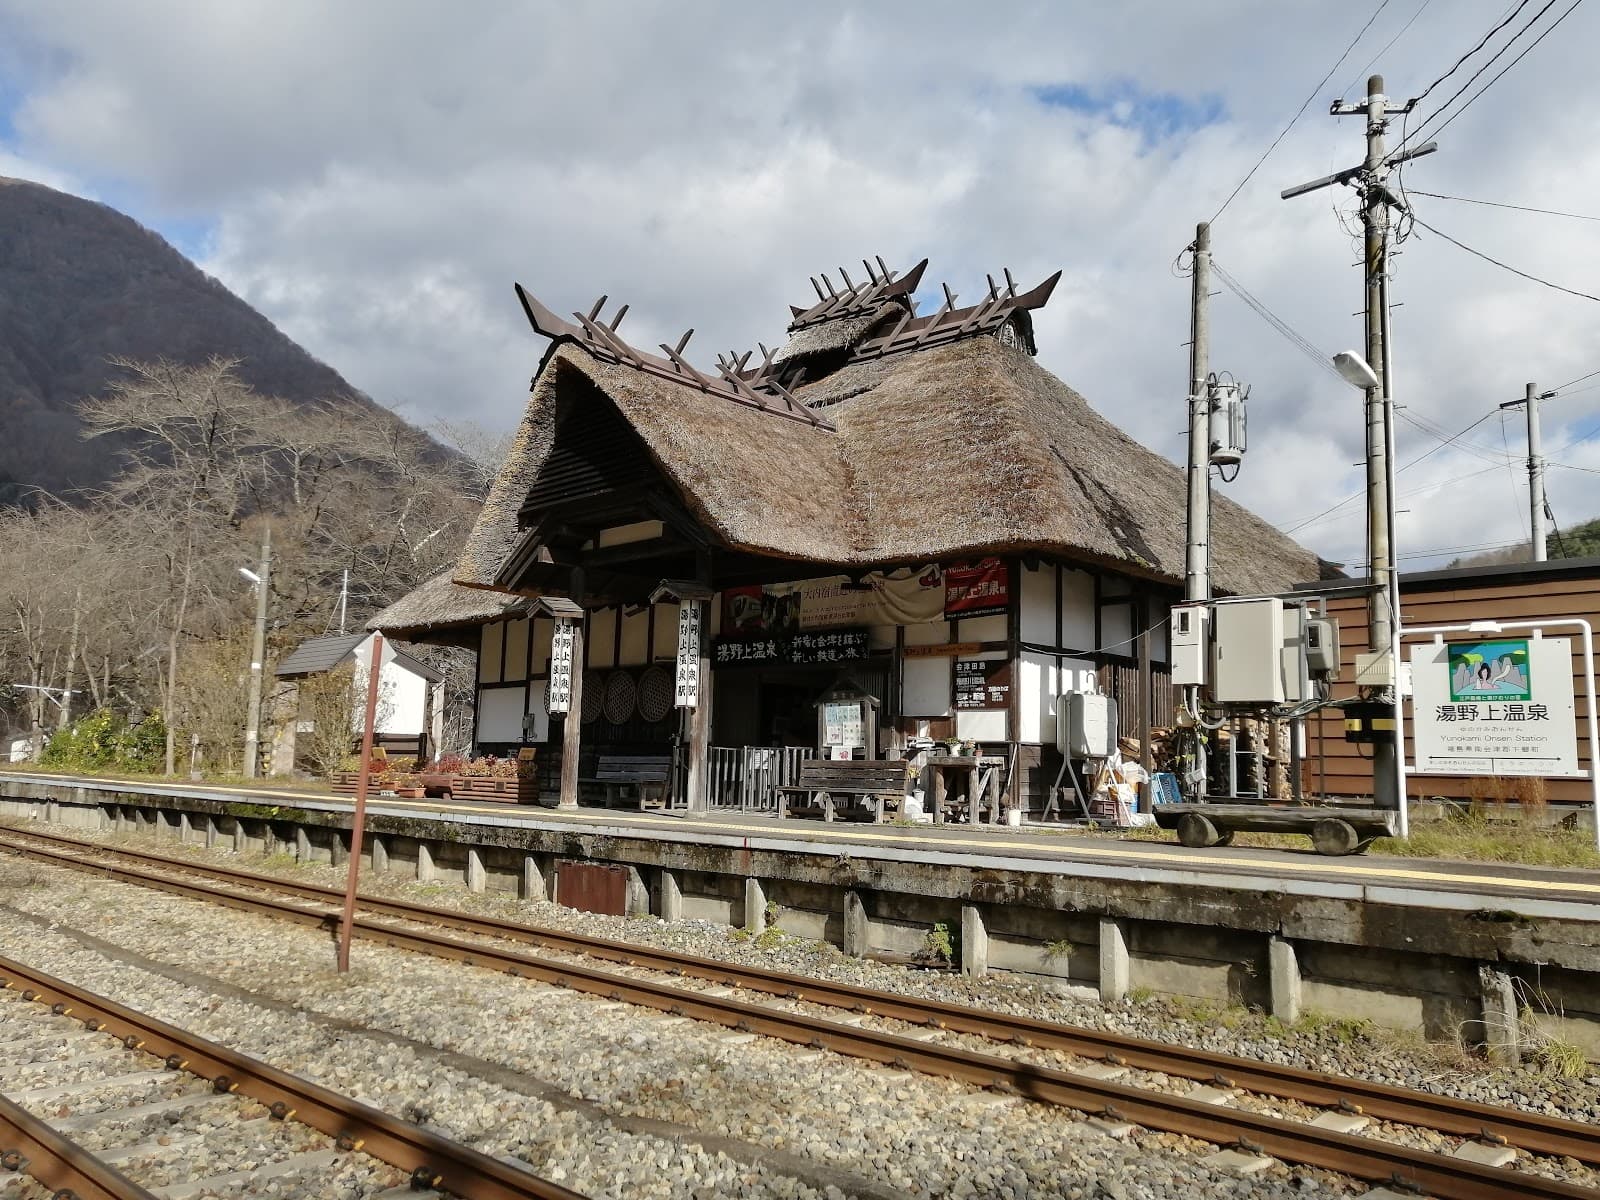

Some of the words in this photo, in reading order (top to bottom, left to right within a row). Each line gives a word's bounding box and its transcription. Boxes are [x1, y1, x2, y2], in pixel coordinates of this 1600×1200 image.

[717, 640, 778, 662] 湯野上温泉
[1435, 704, 1550, 722] 湯野上温泉
